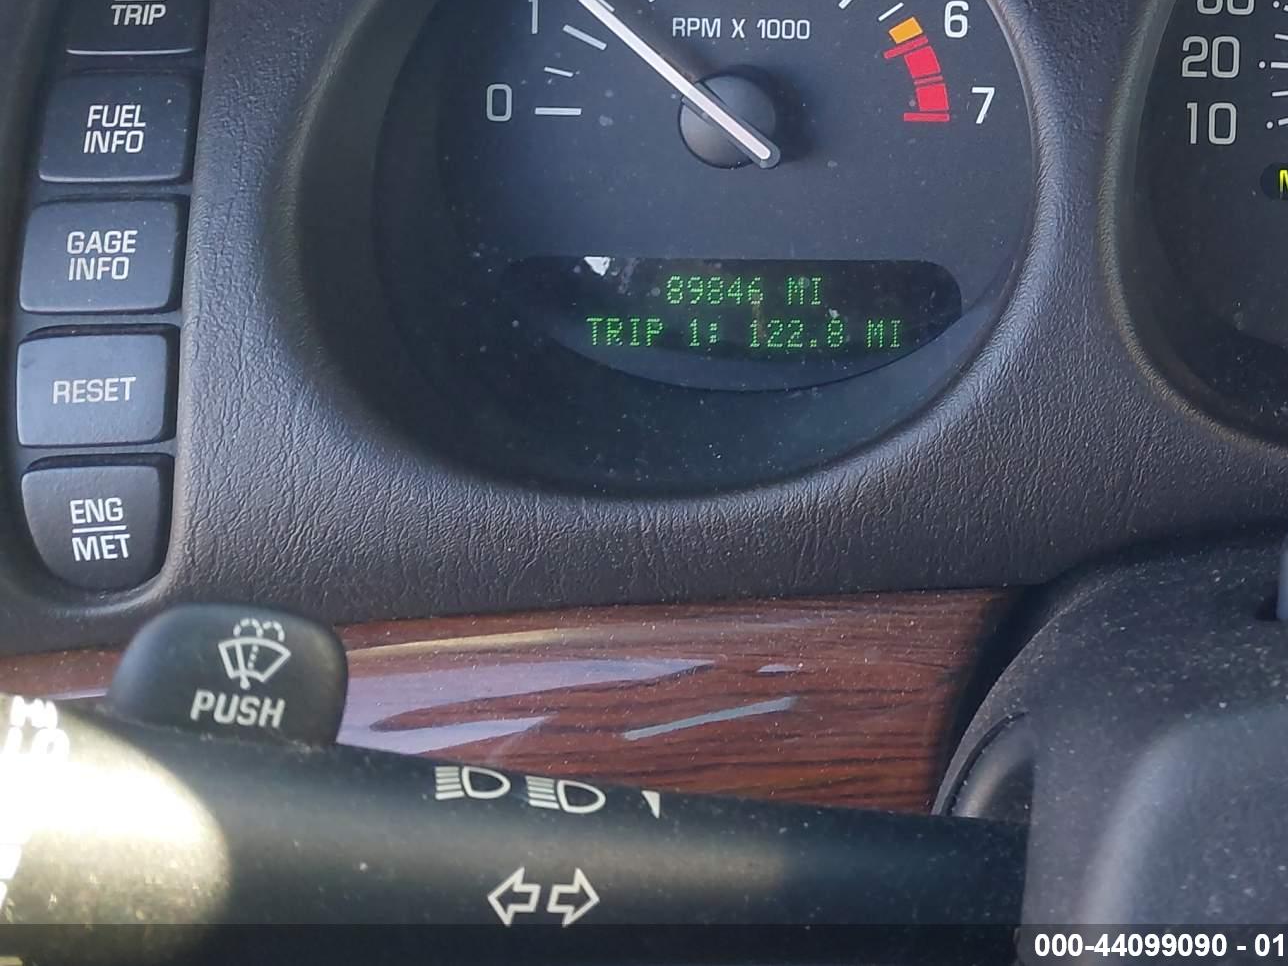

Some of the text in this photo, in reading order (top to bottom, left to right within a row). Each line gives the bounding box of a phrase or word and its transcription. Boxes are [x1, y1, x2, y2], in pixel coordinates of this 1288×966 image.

[111, 4, 166, 25] TRIP
[673, 18, 809, 39] RPM X 1000
[945, 1, 968, 37] 6
[1182, 36, 1239, 78] 20
[487, 84, 512, 121] 0
[972, 87, 994, 123] 7
[88, 105, 146, 130] FUEL
[1187, 103, 1236, 144] 10
[84, 131, 143, 153] INFO
[67, 231, 137, 254] GAGE
[69, 257, 129, 280] INFO
[667, 276, 821, 306] 89846 MI
[587, 318, 900, 347] TRIP 1: 122.8 MI
[53, 377, 136, 404] RESET
[70, 498, 123, 524] ENG
[72, 533, 130, 561] MET
[191, 689, 285, 727] PUSH
